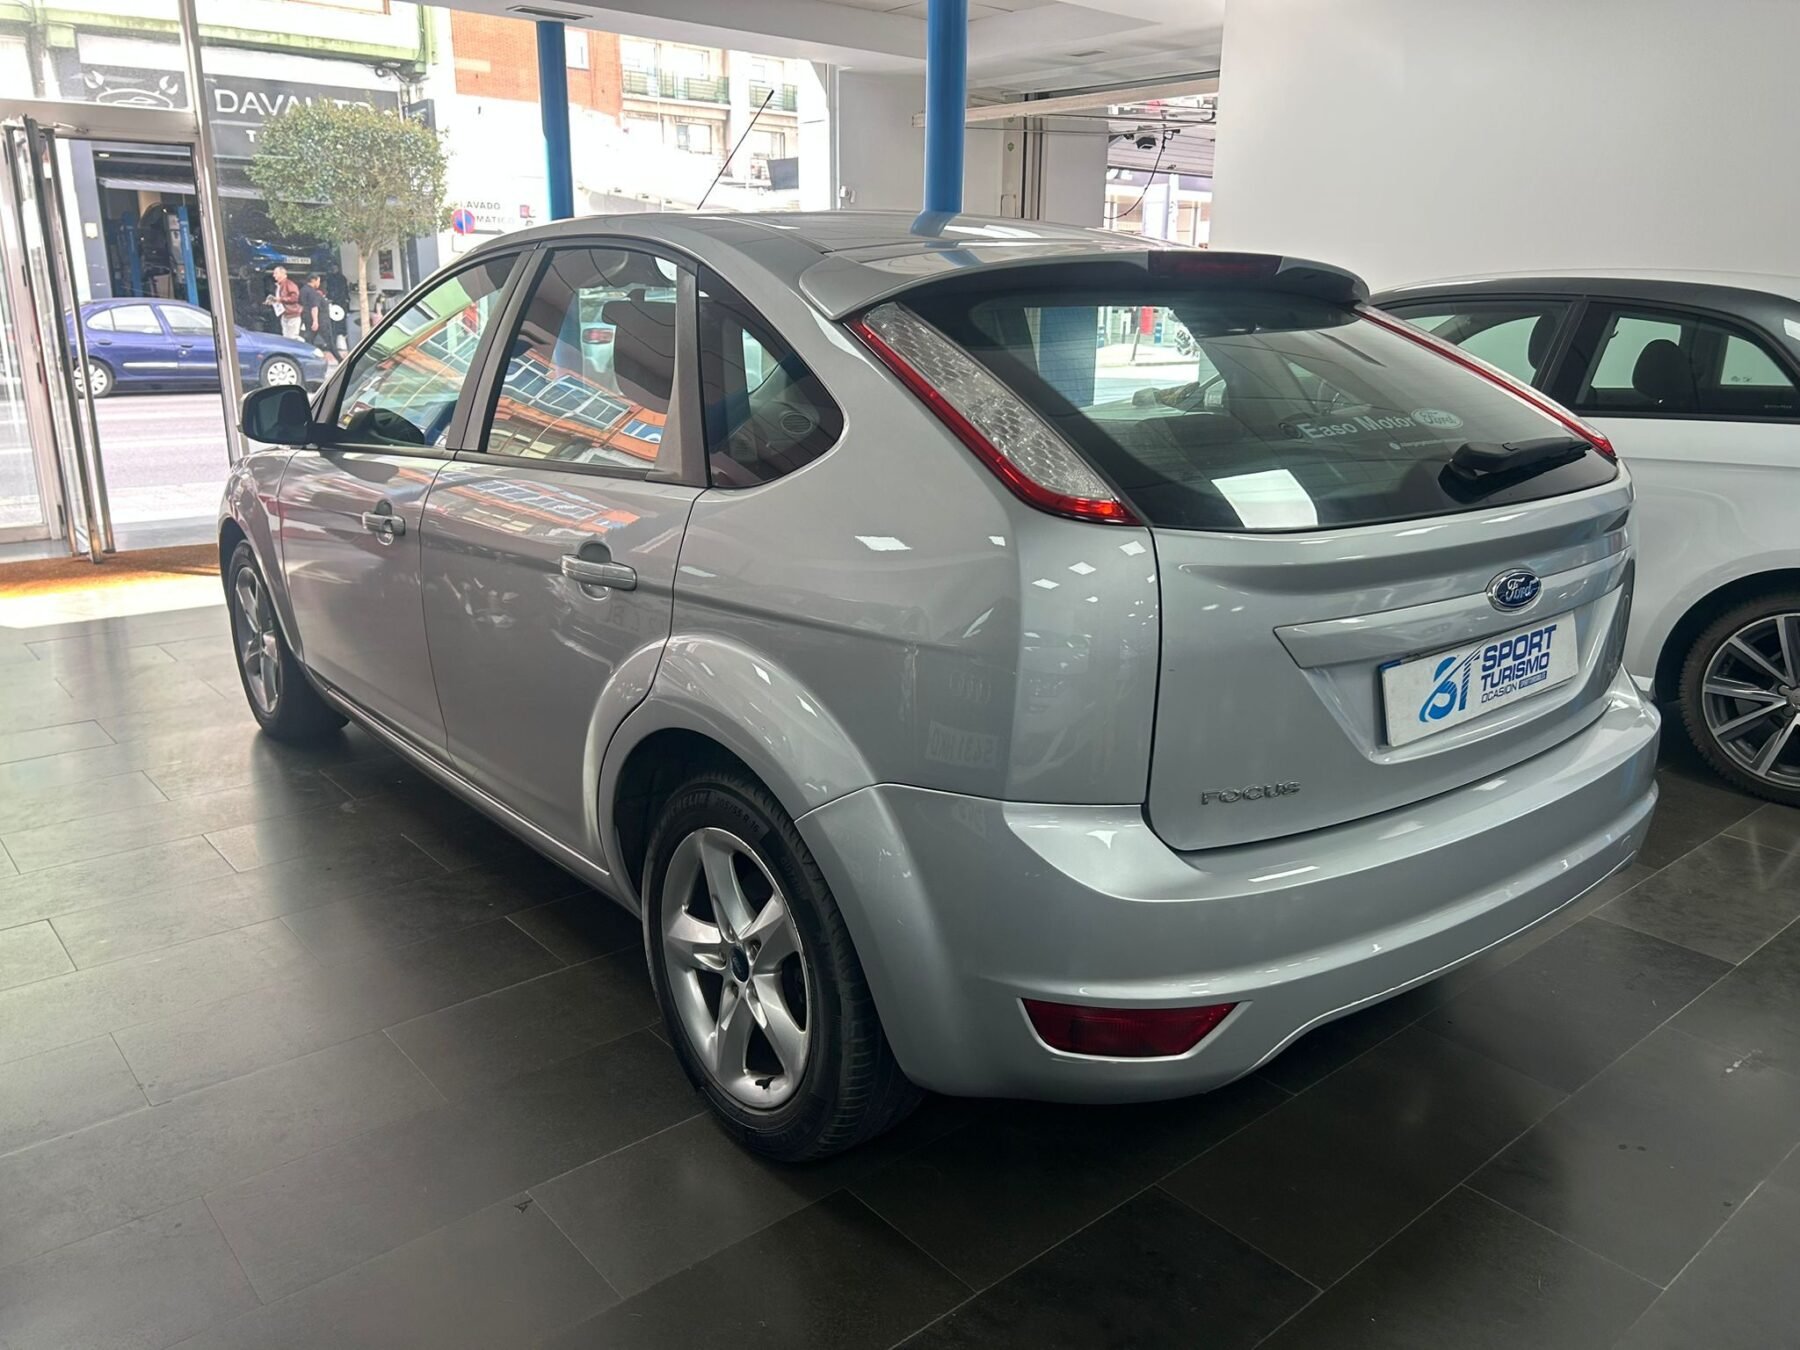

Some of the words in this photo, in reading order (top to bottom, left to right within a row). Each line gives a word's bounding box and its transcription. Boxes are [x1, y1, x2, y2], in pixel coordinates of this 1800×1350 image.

[1297, 422, 1358, 440] Easo
[1354, 415, 1417, 432] Motor
[1503, 576, 1537, 602] Ford
[1482, 624, 1557, 673] SPORT
[1481, 652, 1550, 692] TURISMO
[1201, 781, 1300, 805] FOCUS
